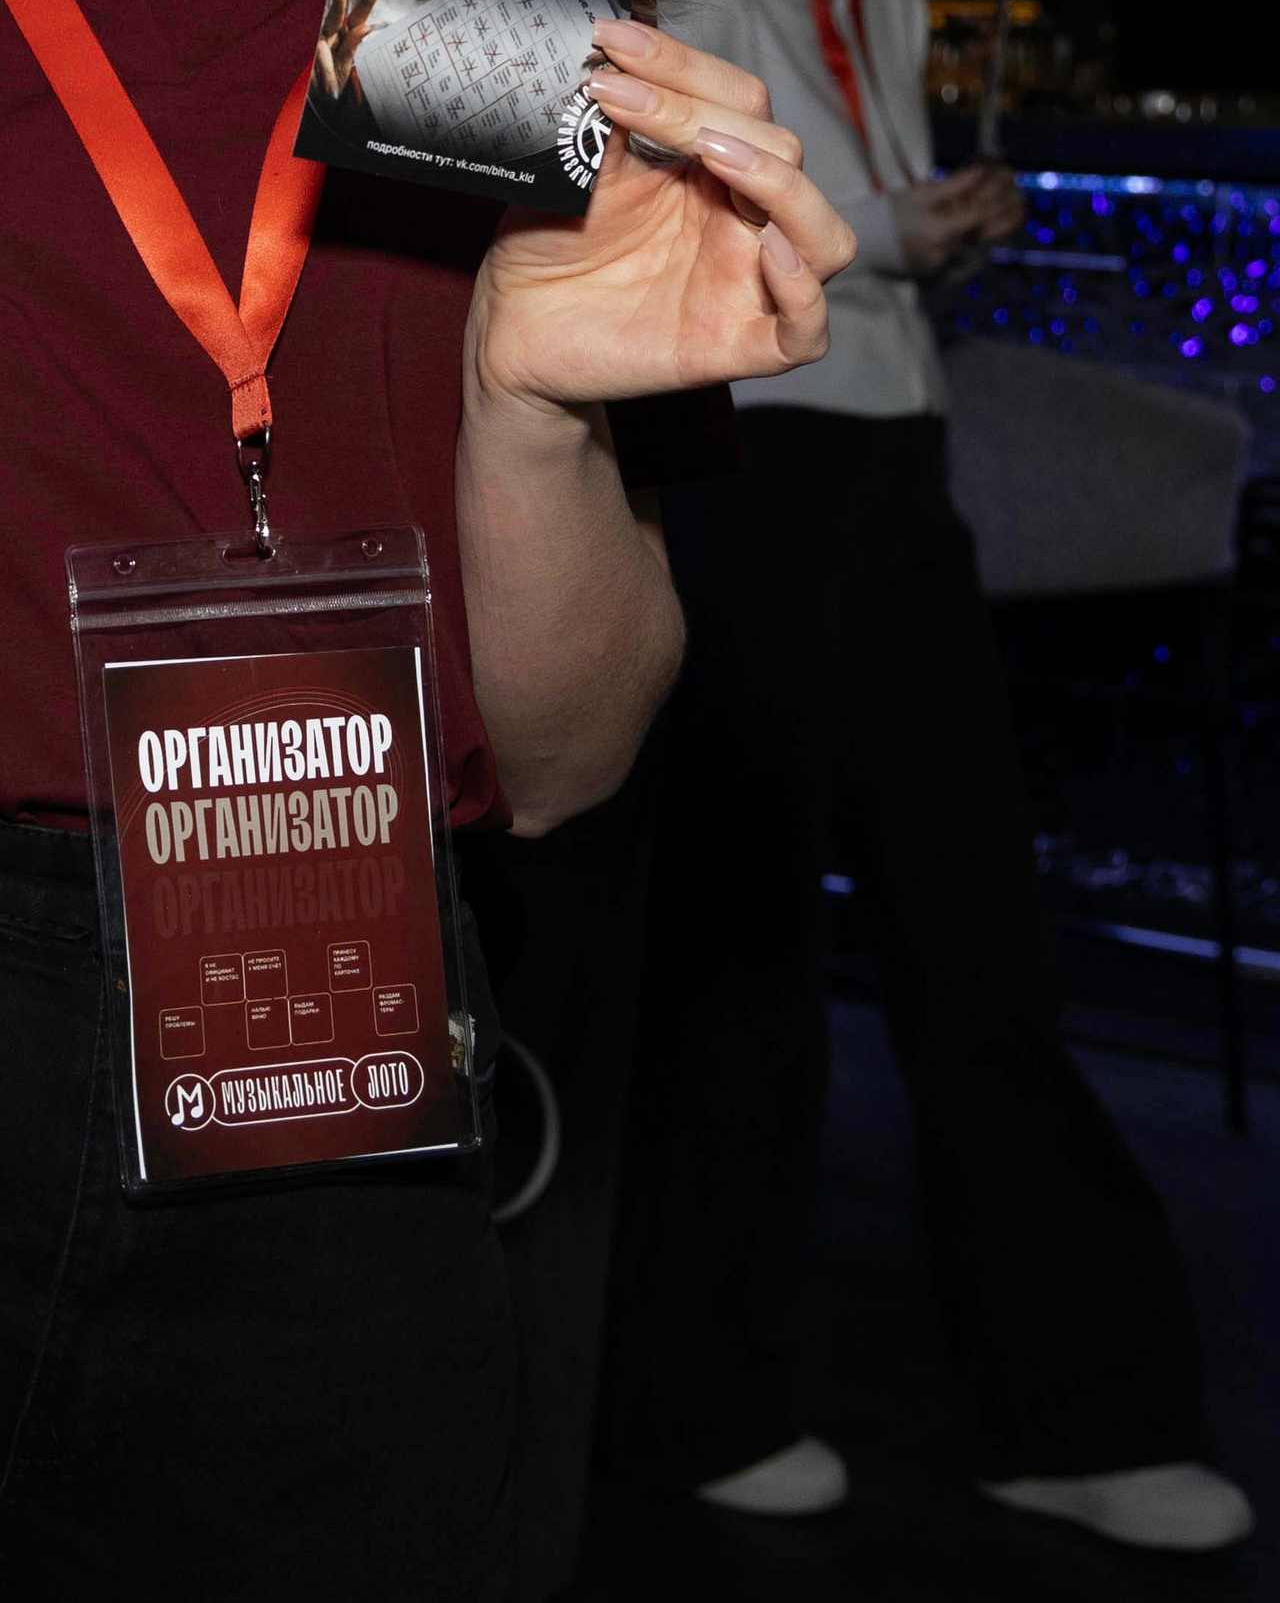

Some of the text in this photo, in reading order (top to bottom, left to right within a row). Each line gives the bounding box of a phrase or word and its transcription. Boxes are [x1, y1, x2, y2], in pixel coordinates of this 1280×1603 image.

[367, 140, 536, 184] подробности тут: vk.com/bitva_kld
[138, 713, 393, 793] ОРГАНИЗАТОР
[145, 783, 399, 865] ОРГАНИЗАТОР
[152, 855, 405, 938] ОРГАНИЗАТОР
[221, 1068, 347, 1116] МУЗЫКАЛЬНОЕ
[367, 1061, 409, 1099] ЛОТО
